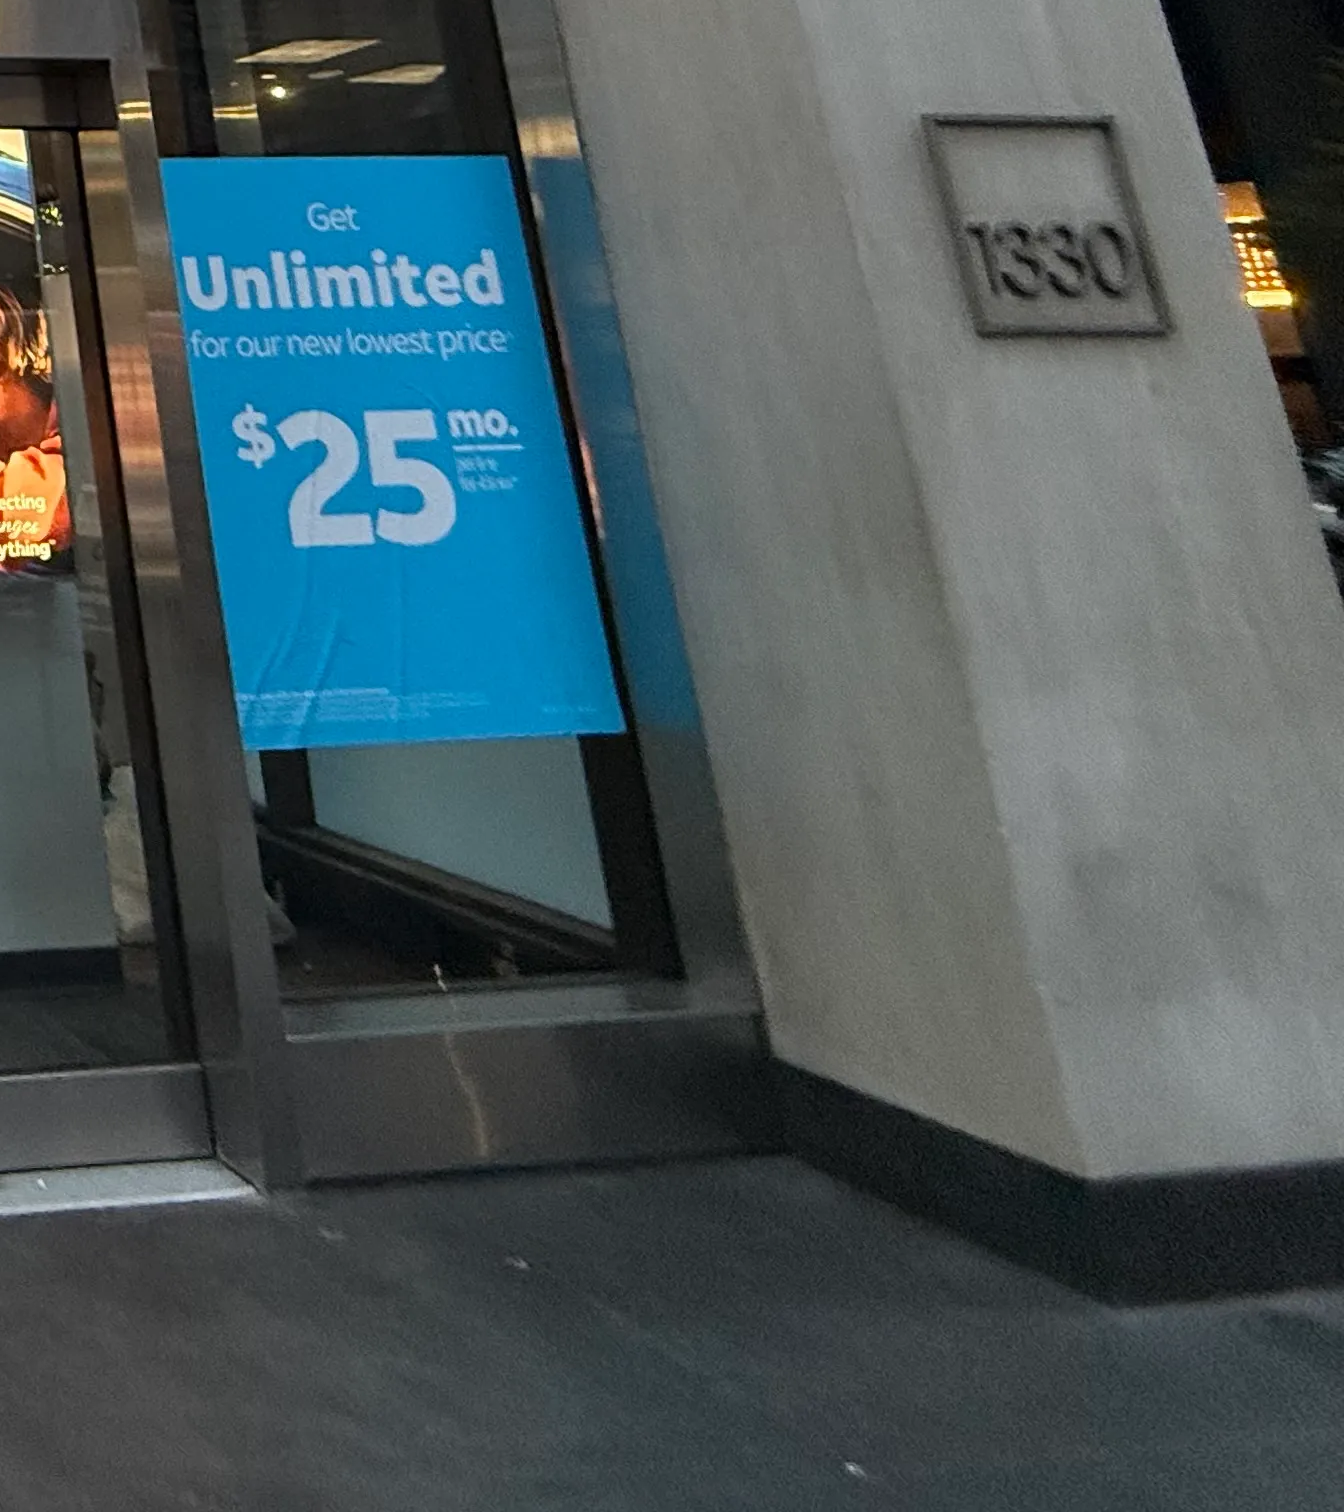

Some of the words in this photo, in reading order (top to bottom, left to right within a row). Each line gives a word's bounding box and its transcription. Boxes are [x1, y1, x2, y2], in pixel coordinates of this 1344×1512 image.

[307, 202, 360, 232] Get
[181, 248, 506, 311] Unlimited
[966, 221, 1134, 299] 1330
[190, 329, 230, 358] for
[235, 335, 280, 358] our
[287, 333, 343, 356] new
[345, 327, 434, 356] lowest
[232, 403, 457, 548] $25
[446, 408, 520, 440] mo.
